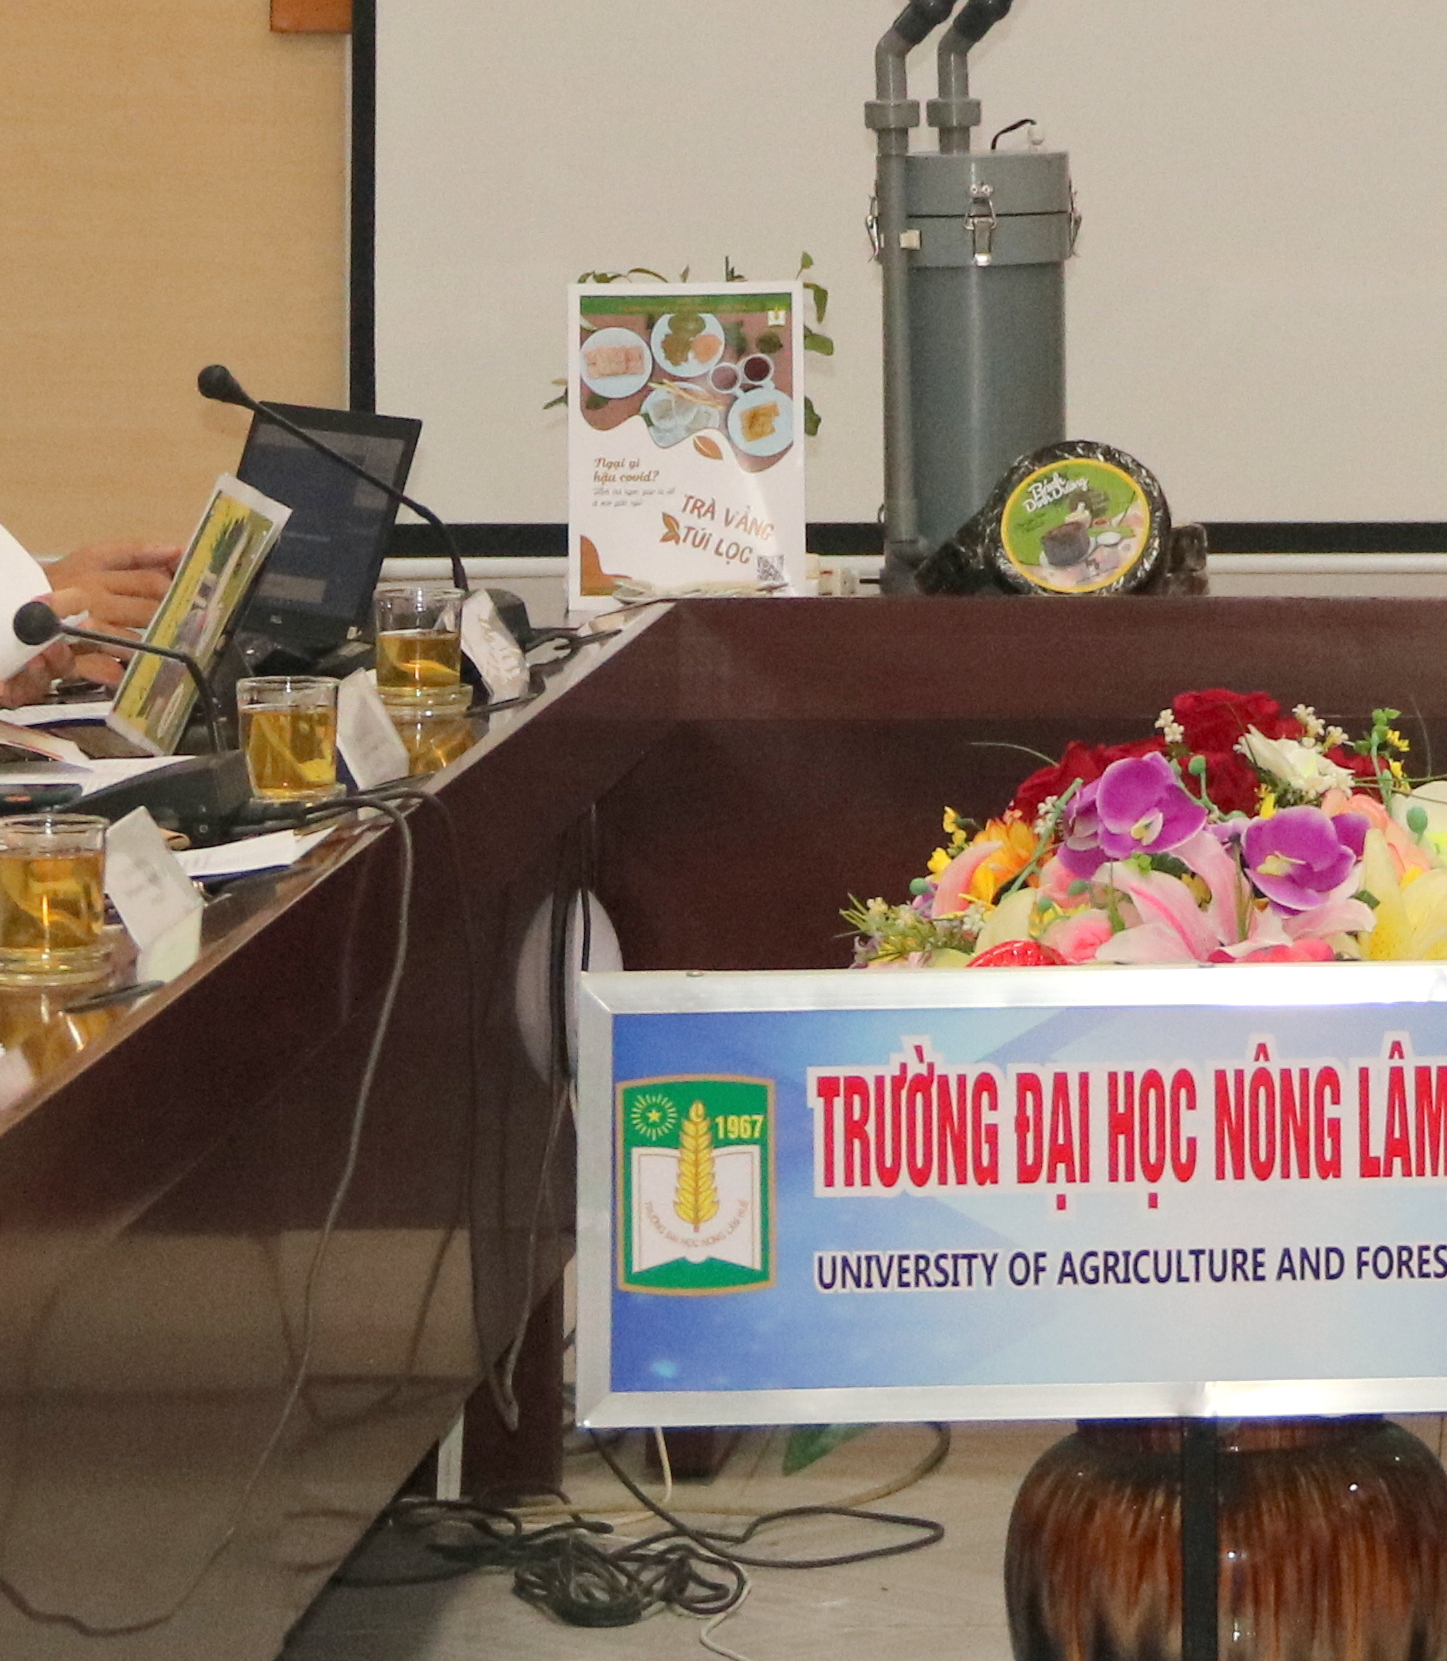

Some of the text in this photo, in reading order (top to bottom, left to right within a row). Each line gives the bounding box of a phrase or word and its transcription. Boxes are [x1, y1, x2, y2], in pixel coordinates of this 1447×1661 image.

[681, 493, 717, 521] TRÀ
[714, 537, 753, 566] LỌC
[714, 1114, 765, 1140] 1967
[816, 1044, 999, 1188] TRƯỜNG
[1014, 1071, 1091, 1211] ĐẠI
[1107, 1067, 1198, 1210] HỌC
[1214, 1042, 1342, 1181] NÔNG
[817, 1251, 999, 1290] UNIVERSITY
[1008, 1251, 1048, 1287] OF
[1057, 1247, 1266, 1286] AGRICULTURE
[1275, 1245, 1345, 1281] AND
